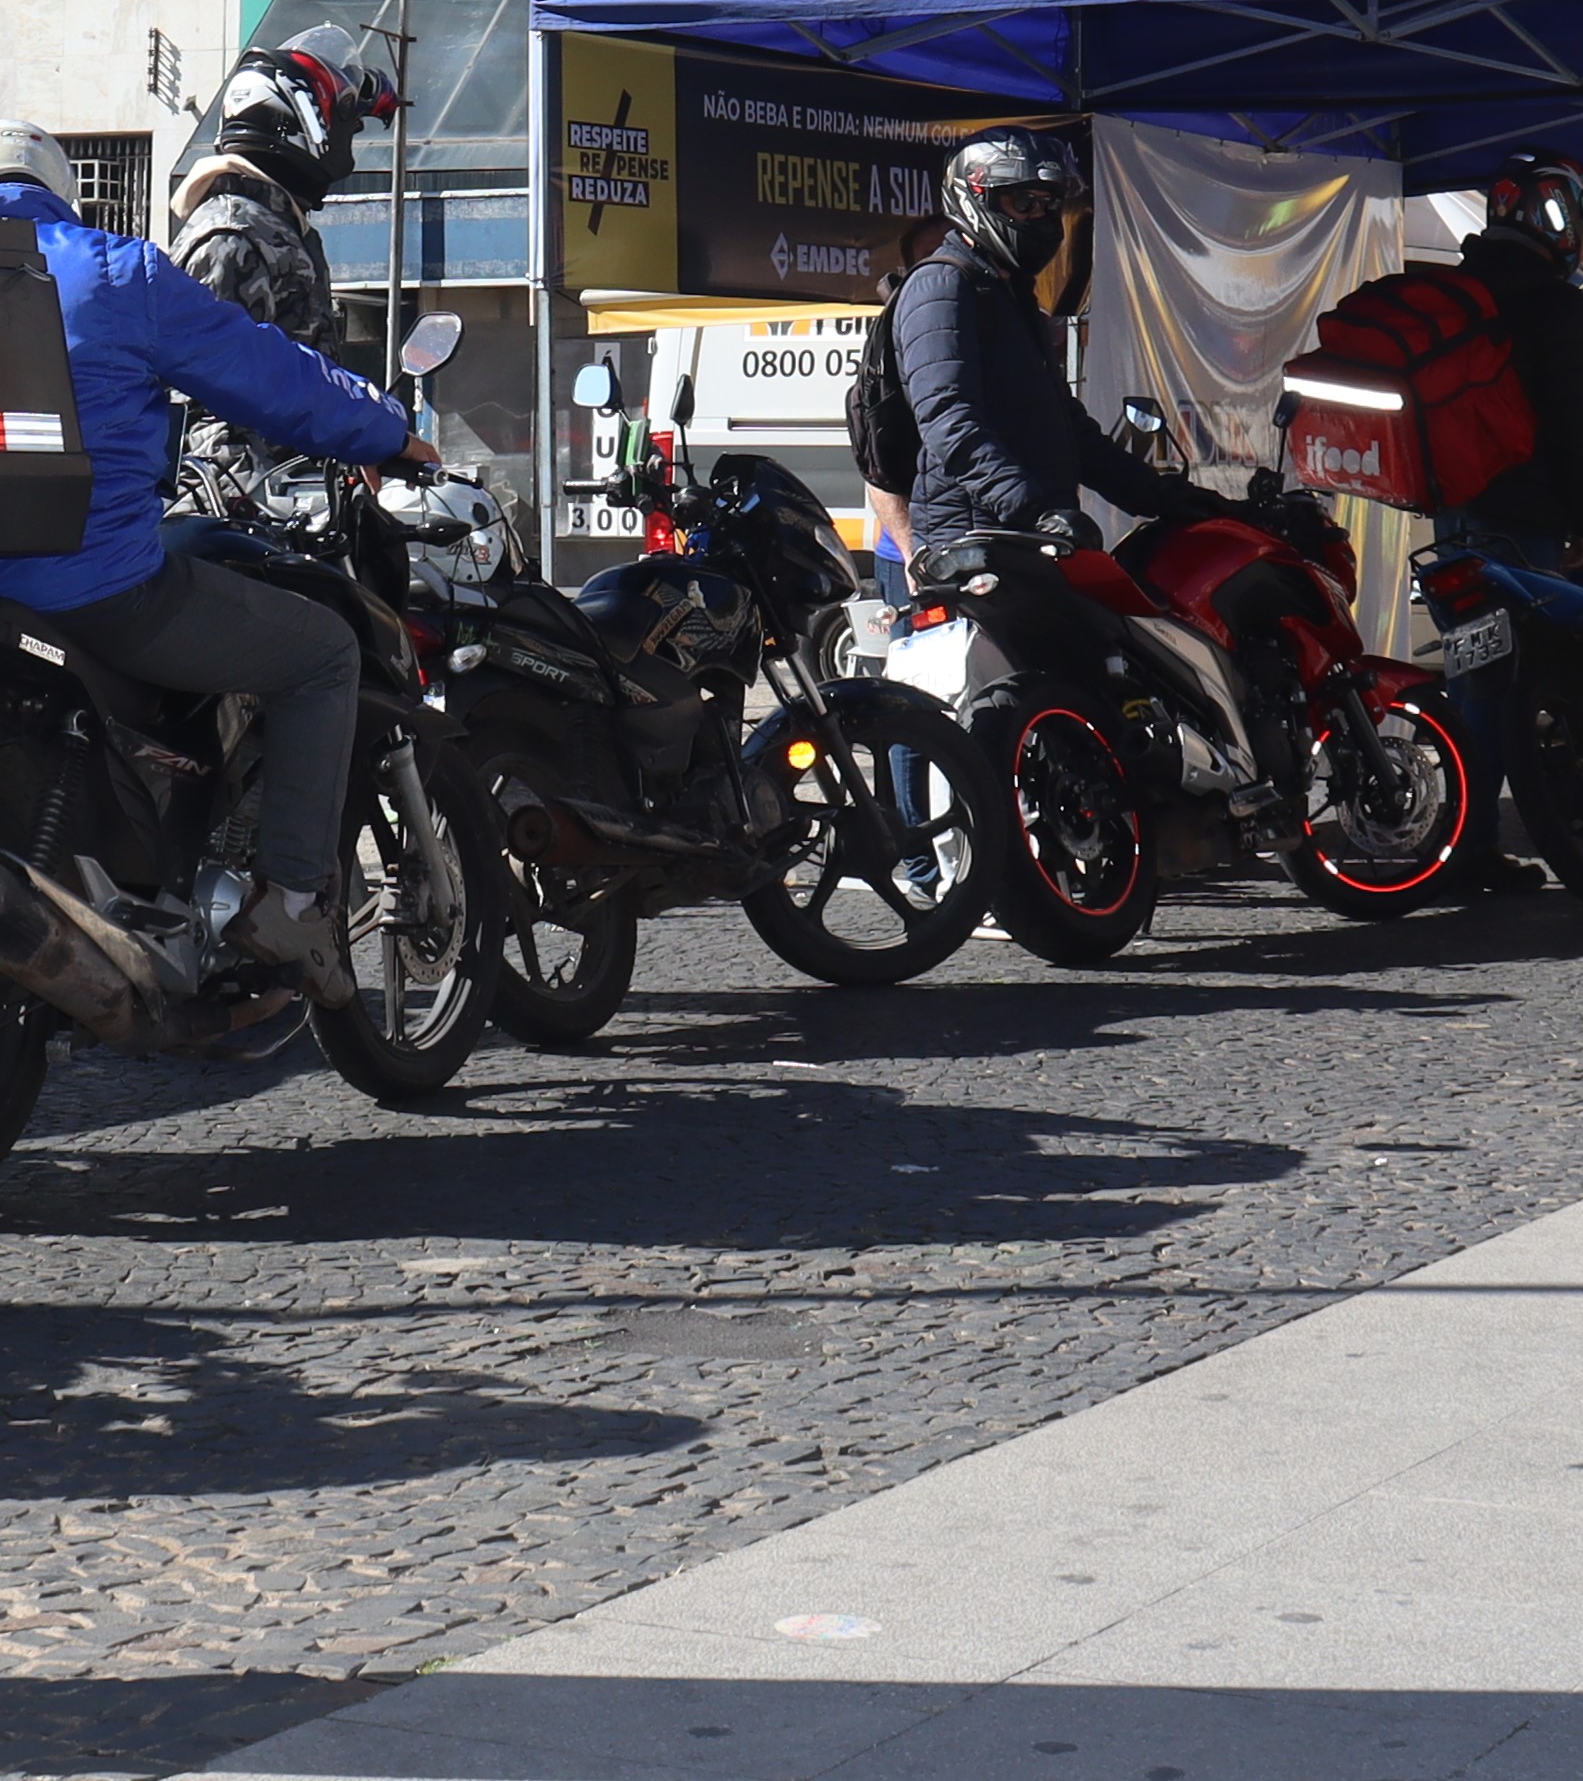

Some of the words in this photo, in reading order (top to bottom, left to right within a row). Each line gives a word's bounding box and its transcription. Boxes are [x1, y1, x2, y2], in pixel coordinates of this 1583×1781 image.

[703, 90, 740, 121] NÃO
[745, 99, 789, 127] BEBA
[793, 105, 802, 129] E
[807, 107, 859, 136] DIRIJA:
[863, 114, 927, 144] NENHUM
[570, 123, 647, 153] RESPEITE
[572, 176, 648, 205] REDUZA
[756, 152, 861, 213] REPENSE
[869, 164, 883, 214] A
[890, 167, 933, 217] SUA
[797, 244, 870, 277] EMDEC
[743, 349, 815, 378] 0800
[1305, 434, 1381, 479] ifood
[572, 508, 637, 532] 3,00
[512, 652, 570, 683] SPORT
[1457, 639, 1503, 671] 1732
[134, 744, 211, 776] FAN
